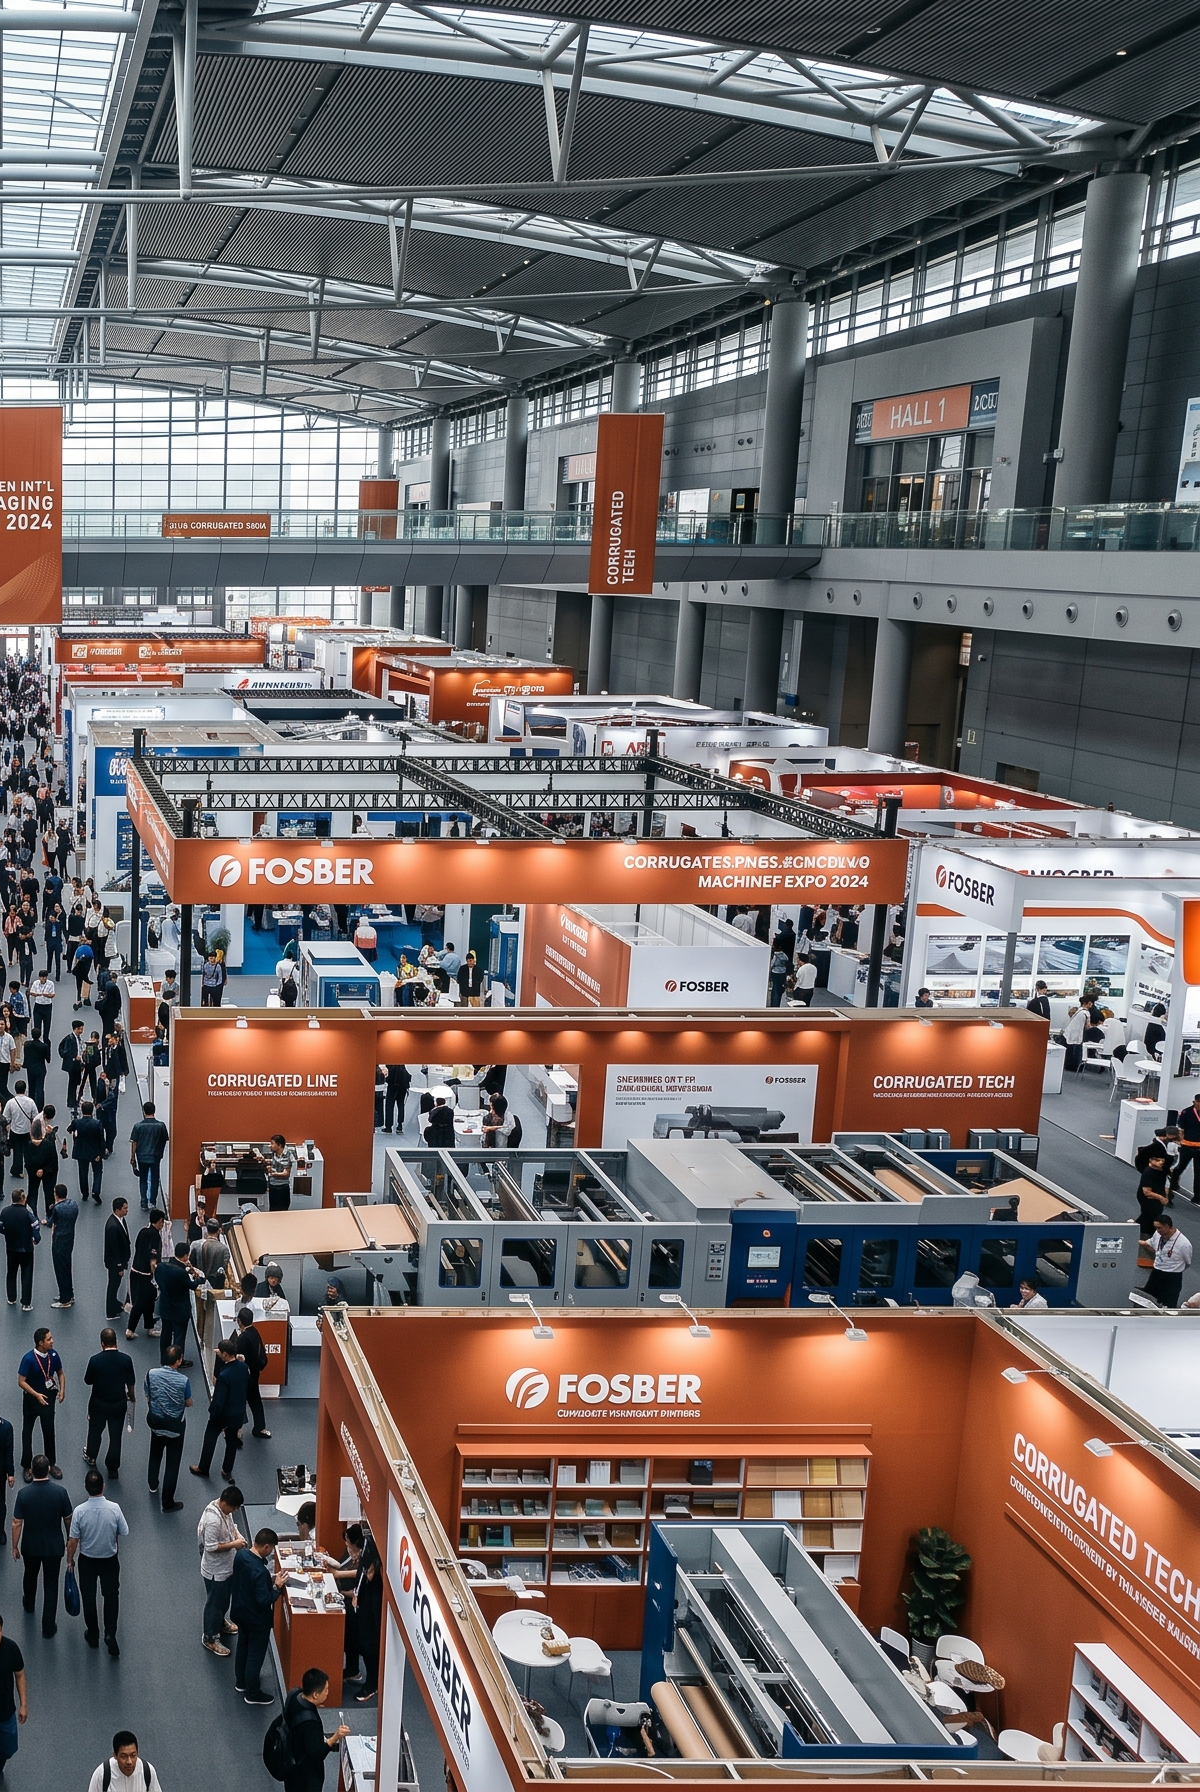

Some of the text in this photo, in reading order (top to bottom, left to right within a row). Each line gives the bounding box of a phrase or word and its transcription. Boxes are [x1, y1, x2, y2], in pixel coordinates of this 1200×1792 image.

[890, 400, 933, 430] HALL
[938, 397, 946, 423] 1
[20, 480, 55, 492] INT'L
[6, 513, 53, 531] 2024
[606, 490, 625, 586] CORRUGATED
[248, 857, 375, 886] FOSBER
[784, 875, 828, 888] EXPO
[829, 875, 869, 888] 2024
[947, 870, 995, 907] FOSBER
[679, 980, 730, 993] FOSBER
[207, 1073, 338, 1088] CORRUGATED LINE
[873, 1075, 1016, 1089] CORRUGATED TECH
[557, 1373, 702, 1405] FOSBER
[1013, 1432, 1138, 1562] CORRUGATED
[1143, 1541, 1200, 1624] TECH
[1106, 1562, 1118, 1582] BY
[412, 1571, 472, 1753] FOSBER
